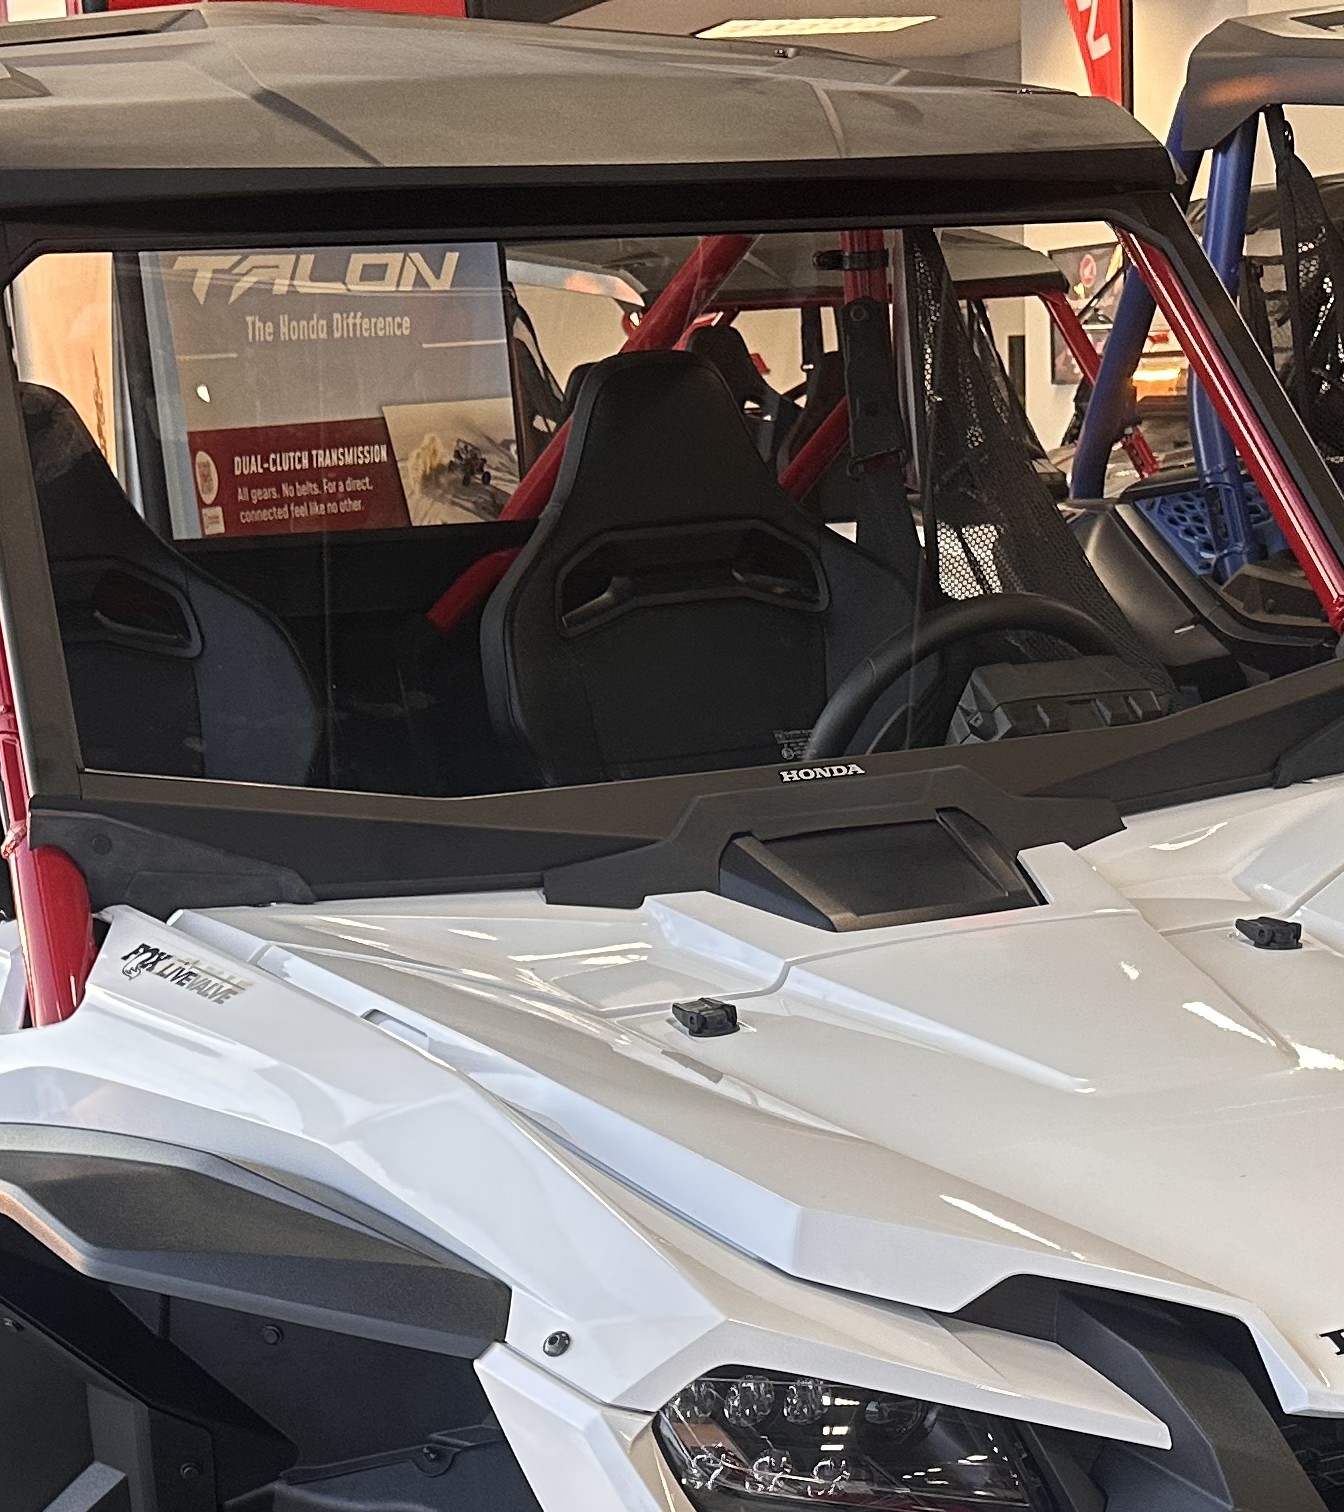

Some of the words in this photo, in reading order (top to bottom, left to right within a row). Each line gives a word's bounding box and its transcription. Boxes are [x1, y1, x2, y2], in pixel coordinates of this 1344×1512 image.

[172, 251, 459, 304] TALON
[246, 315, 274, 342] The
[279, 312, 327, 341] Honda
[333, 314, 411, 338] Difference
[234, 450, 309, 476] DUAL-CLUTCH
[311, 444, 388, 468] TRANSMISSION
[238, 486, 250, 502] All
[250, 486, 281, 504] gears.
[282, 482, 295, 498] No
[323, 478, 337, 494] For
[338, 480, 345, 492] a
[240, 504, 289, 523] connected
[290, 502, 308, 518] feel
[309, 501, 325, 516] like
[327, 502, 338, 515] no
[780, 763, 866, 782] HONDA
[121, 943, 174, 980] FOX
